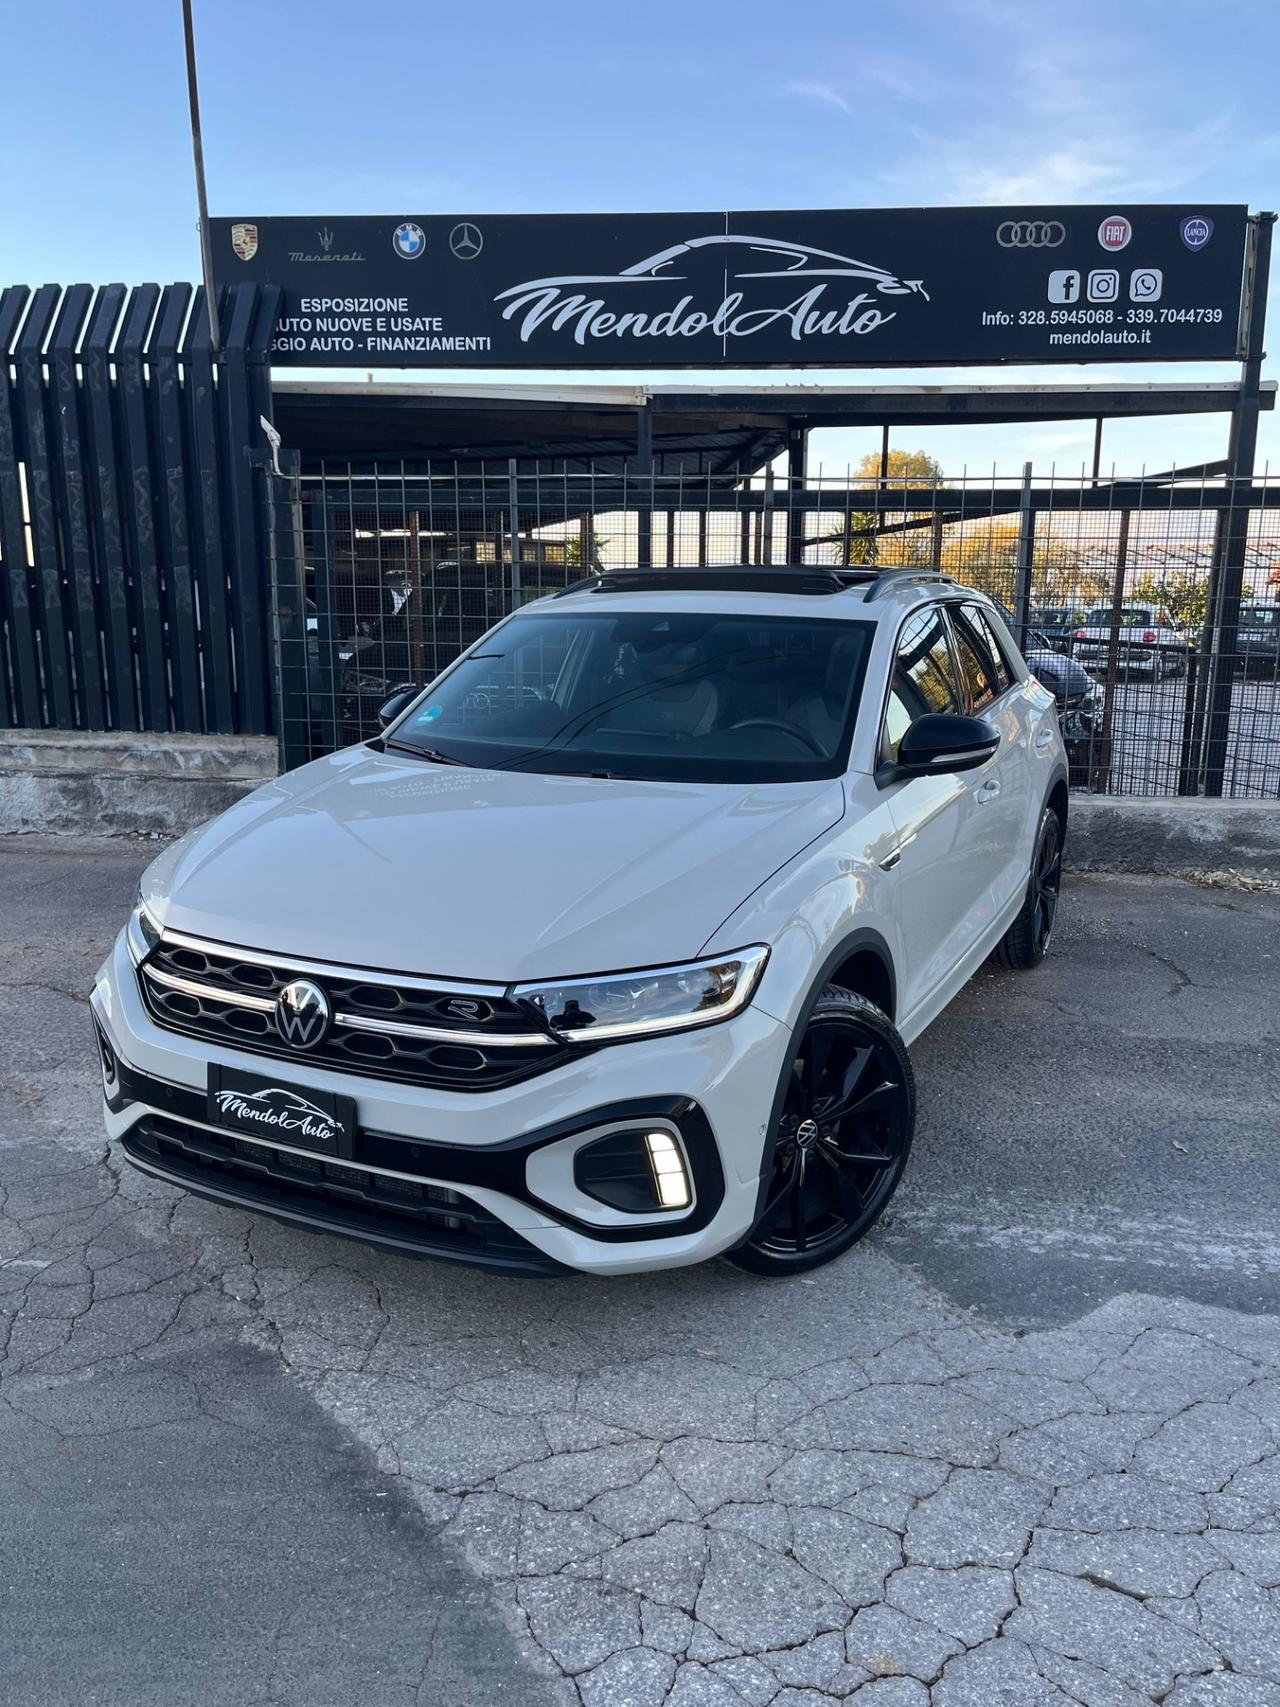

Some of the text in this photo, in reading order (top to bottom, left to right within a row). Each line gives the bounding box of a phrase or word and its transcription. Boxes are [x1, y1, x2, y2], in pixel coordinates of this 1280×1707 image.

[1105, 225, 1126, 242] FIAT
[1186, 227, 1206, 238] LANCIA
[301, 298, 408, 313] ESPOSIZIONE
[275, 317, 443, 332] UTO NUOVE E USATE
[982, 311, 1014, 326] Info:
[1018, 310, 1114, 325] 328.5945068
[1126, 308, 1223, 324] 339.7044739
[310, 337, 354, 351] AUTO
[367, 336, 491, 351] FINANZIAMENTI
[1049, 329, 1151, 345] mendolauto.it
